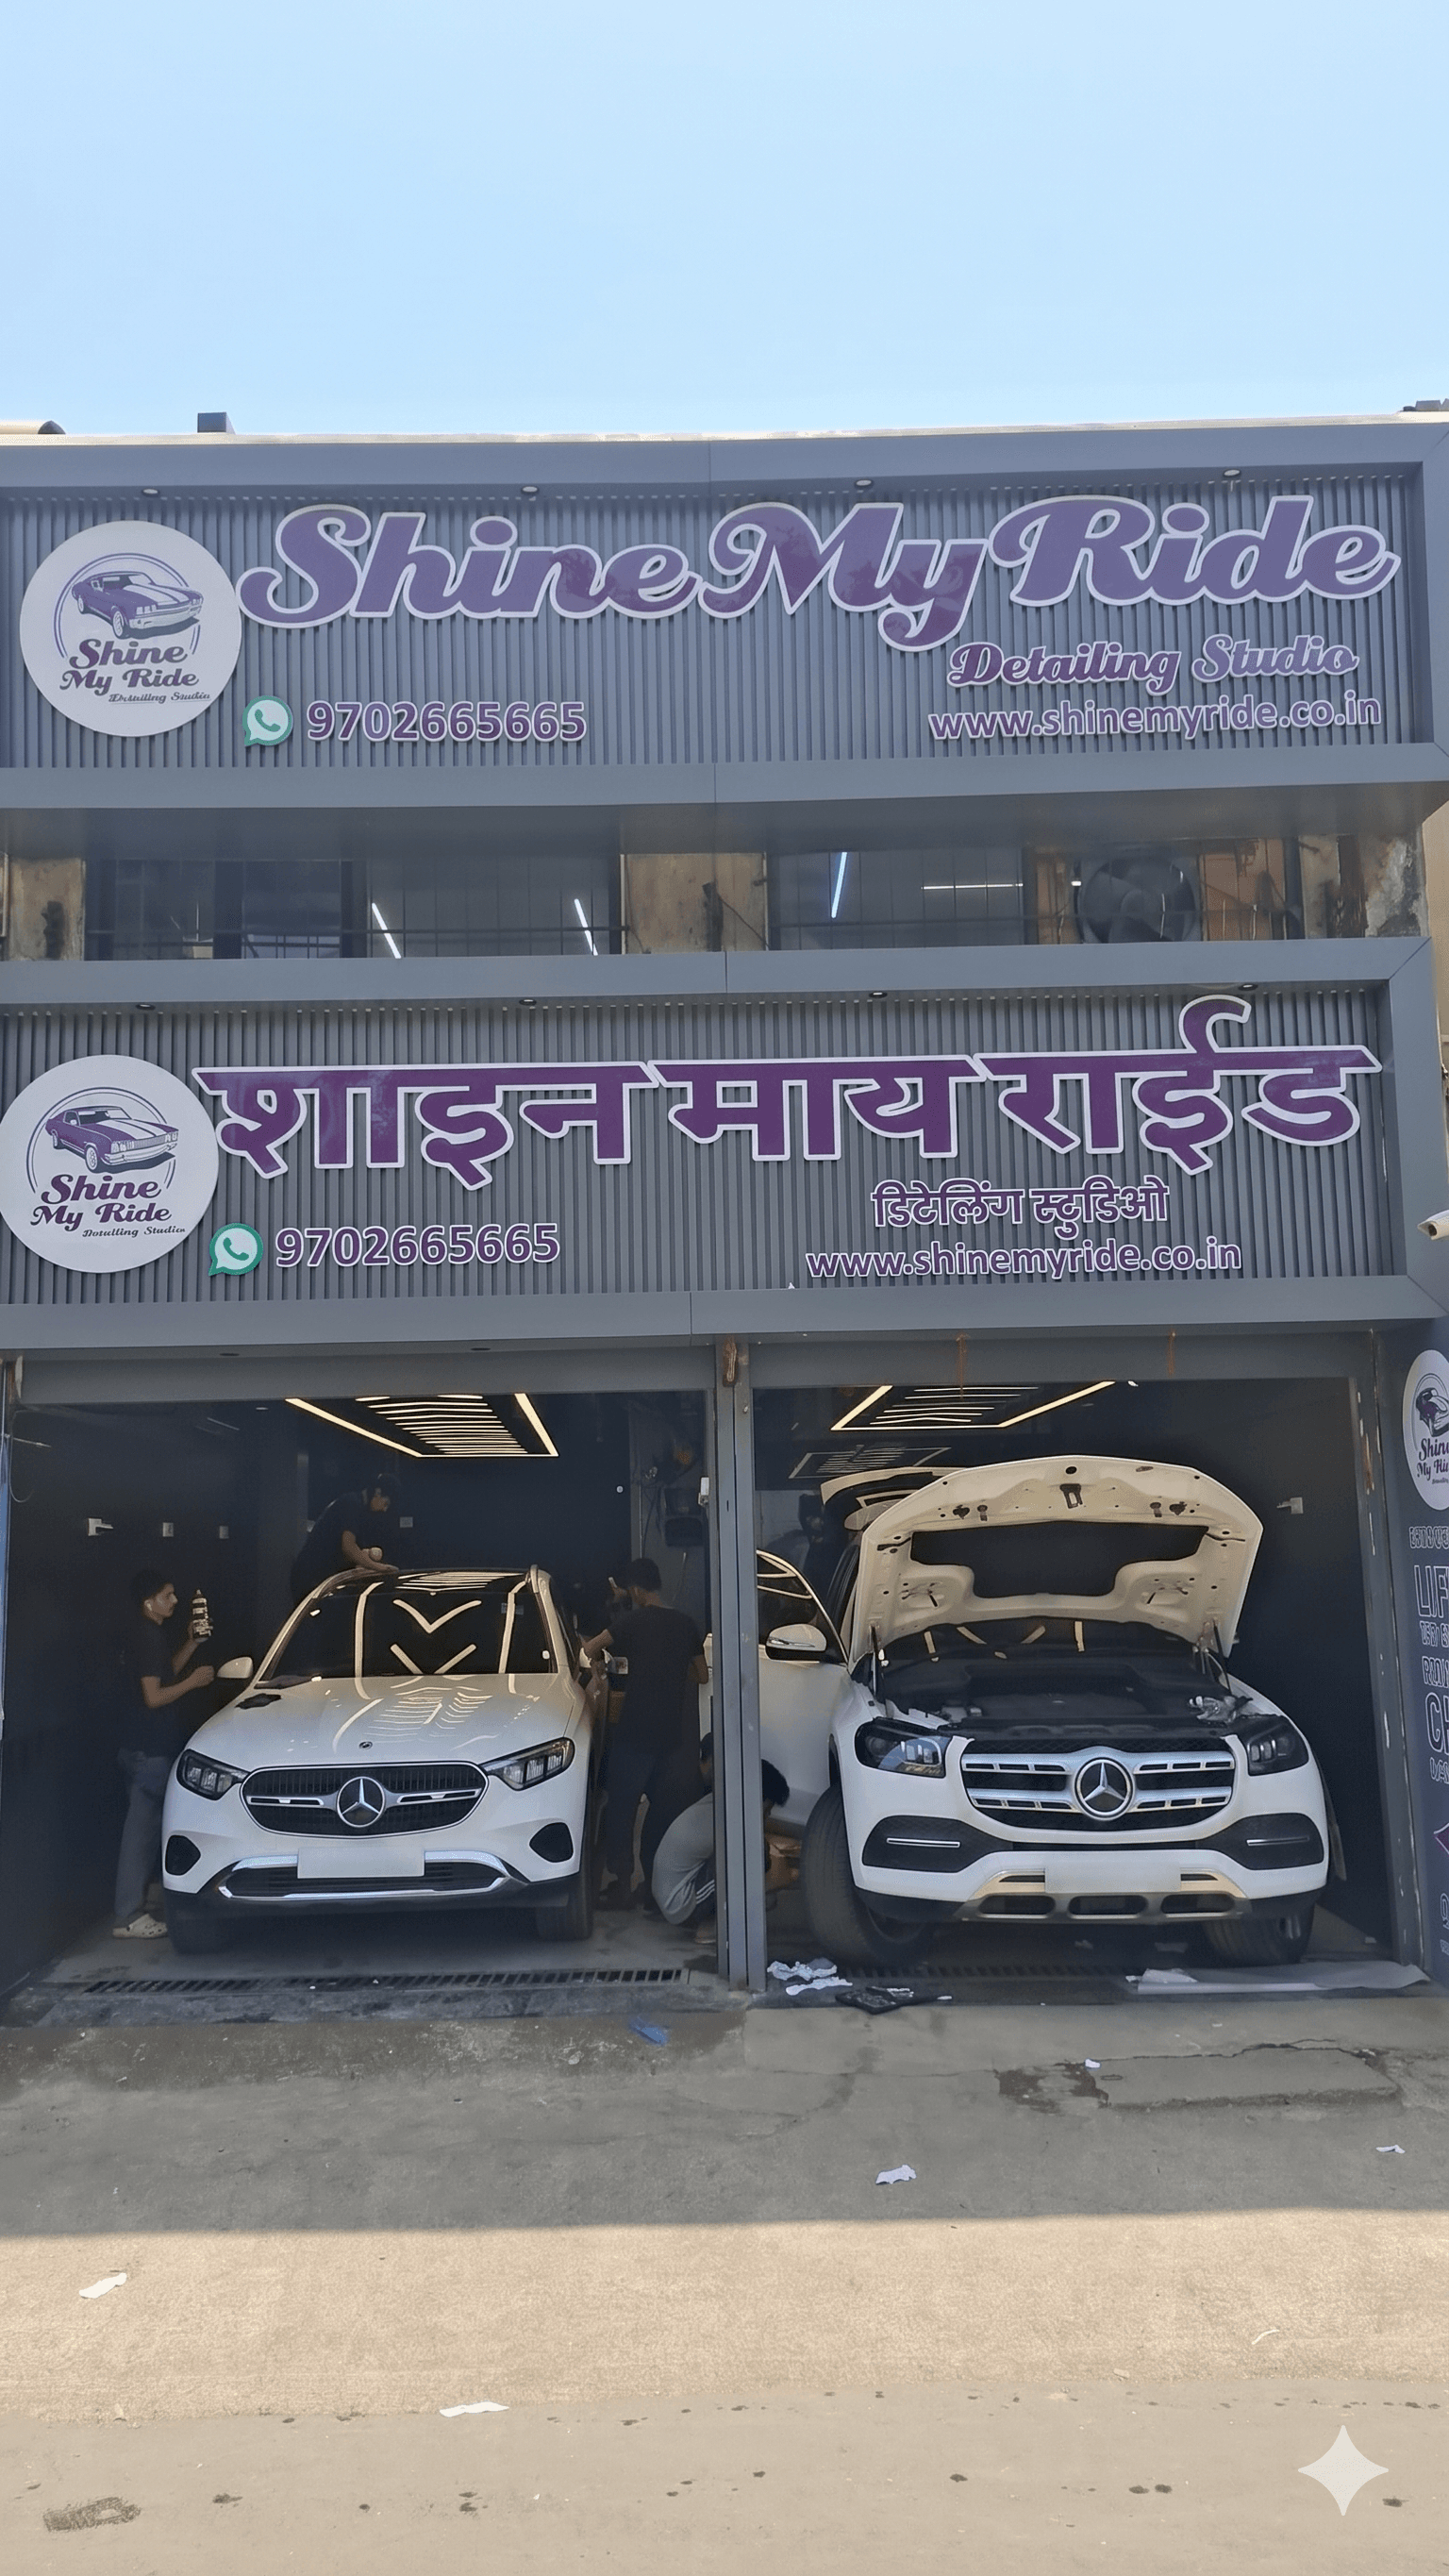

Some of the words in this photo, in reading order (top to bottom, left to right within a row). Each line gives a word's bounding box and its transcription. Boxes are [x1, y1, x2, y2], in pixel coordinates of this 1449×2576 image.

[69, 638, 189, 669] Shine
[946, 641, 1182, 696] Detailing
[1191, 633, 1360, 684] Studio
[59, 669, 112, 696] My
[122, 667, 199, 688] Ride
[307, 699, 587, 744] 9702665665
[928, 690, 1382, 741] www.shinemyride.co.in
[192, 1062, 658, 1192] शाइन
[647, 1054, 988, 1162] माय
[973, 995, 1383, 1175] राईड
[41, 1174, 162, 1205] Shine
[871, 1179, 1024, 1229] डिटेलिंग
[1029, 1174, 1170, 1240] स्टुडिओ
[30, 1205, 84, 1232] My
[94, 1202, 172, 1224] Ride
[275, 1223, 560, 1268] 9702665665
[807, 1235, 1242, 1280] www.shinemyride.co.in
[1419, 1437, 1449, 1462] Shin
